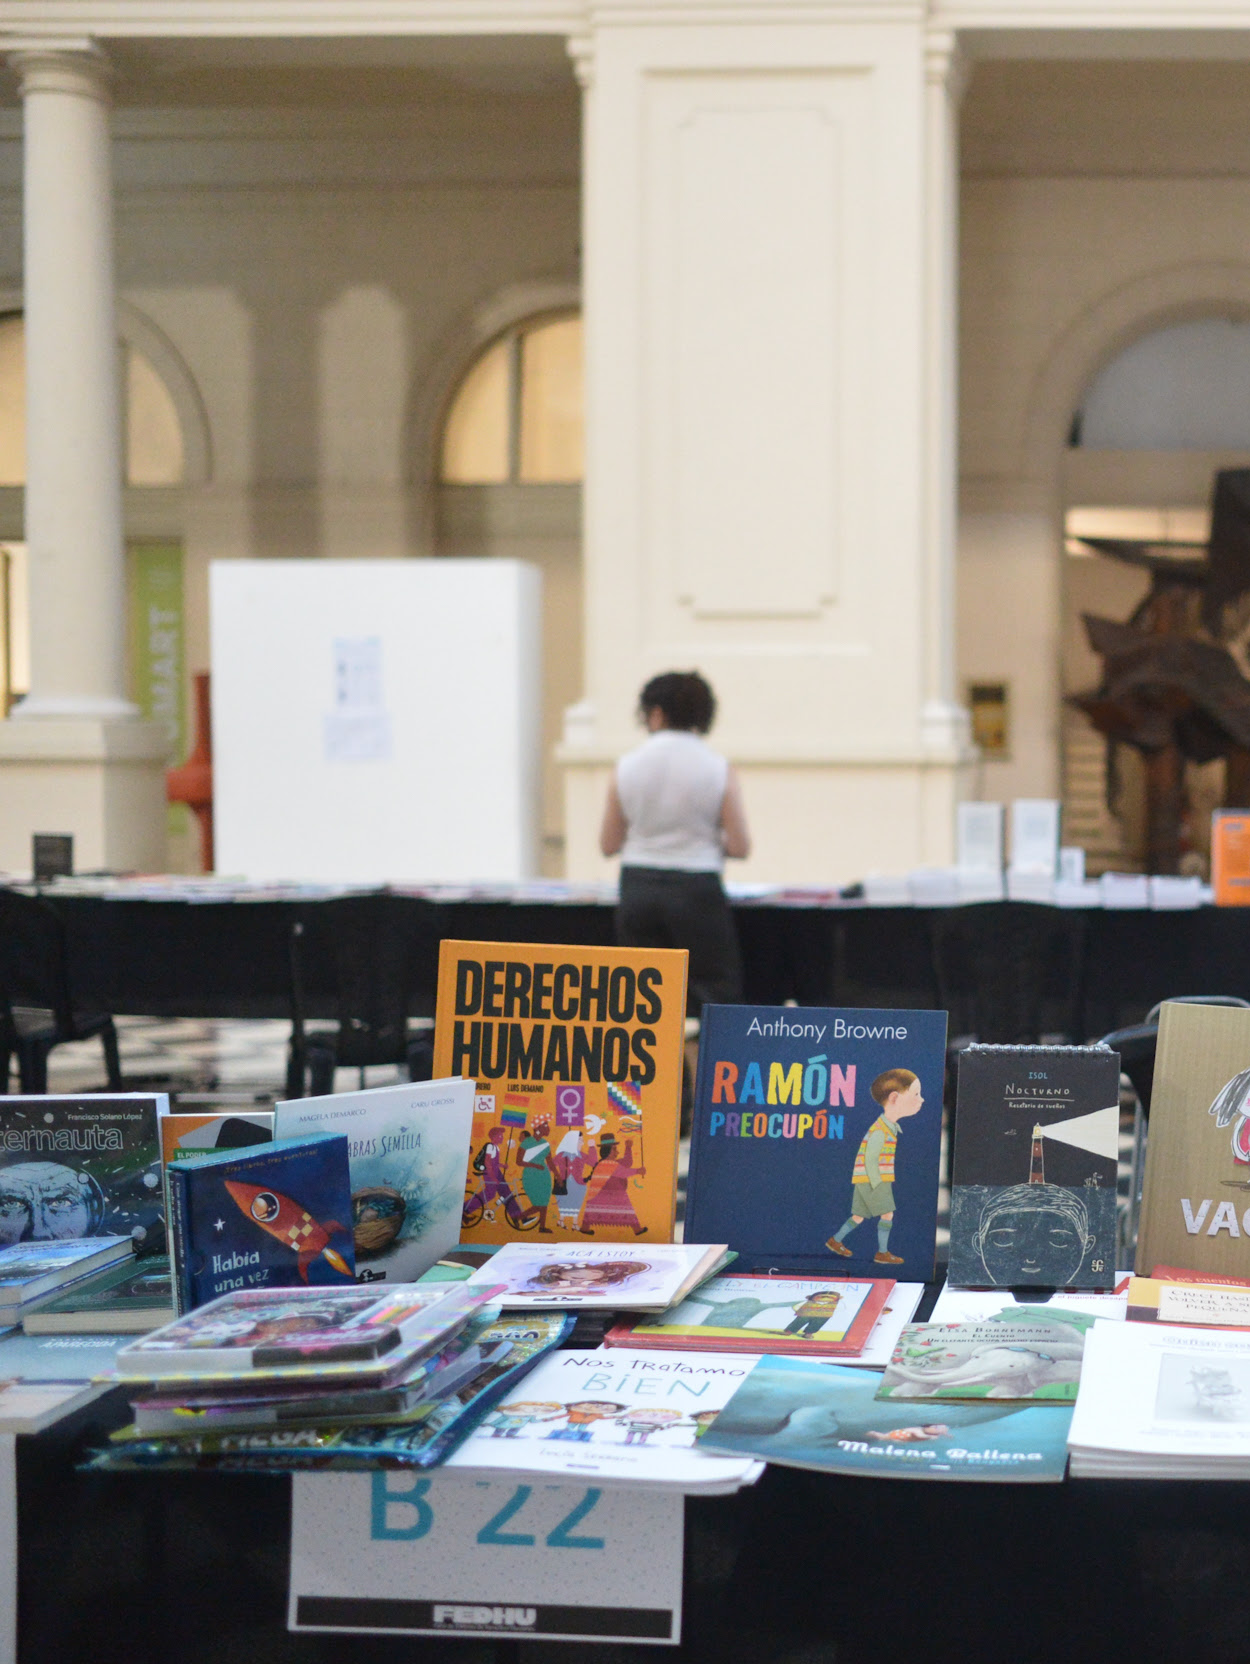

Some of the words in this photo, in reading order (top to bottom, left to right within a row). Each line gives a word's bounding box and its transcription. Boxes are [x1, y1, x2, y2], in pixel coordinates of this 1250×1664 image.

[455, 959, 663, 1024] DERECHOS
[747, 1016, 827, 1044] Anthony
[834, 1019, 908, 1040] Browne
[452, 1021, 657, 1085] HUMANOS
[712, 1054, 857, 1107] RAMÓN
[1028, 1071, 1048, 1080] ISOL
[507, 1084, 519, 1092] LUIS
[521, 1085, 544, 1093] DEMANO
[1005, 1083, 1070, 1095] NOCTURNO
[123, 1113, 143, 1121] López
[300, 1113, 329, 1123] MAGELA
[331, 1108, 367, 1118] DEMARCO
[411, 1101, 430, 1109] CARU
[431, 1098, 455, 1106] GROSSI
[710, 1109, 844, 1140] PREOCUPÓN
[381, 1132, 422, 1158] SEMILLA
[214, 1276, 244, 1292] una
[249, 1268, 269, 1283] vez
[1165, 1275, 1193, 1283] Los
[1195, 1277, 1247, 1286] cuentos
[1168, 1296, 1219, 1306] VOLVER
[563, 1358, 614, 1368] Nos
[837, 1440, 937, 1459] Malena
[946, 1448, 1043, 1461] Ballena
[370, 1470, 434, 1541] B
[433, 1605, 537, 1626] FEDHU
